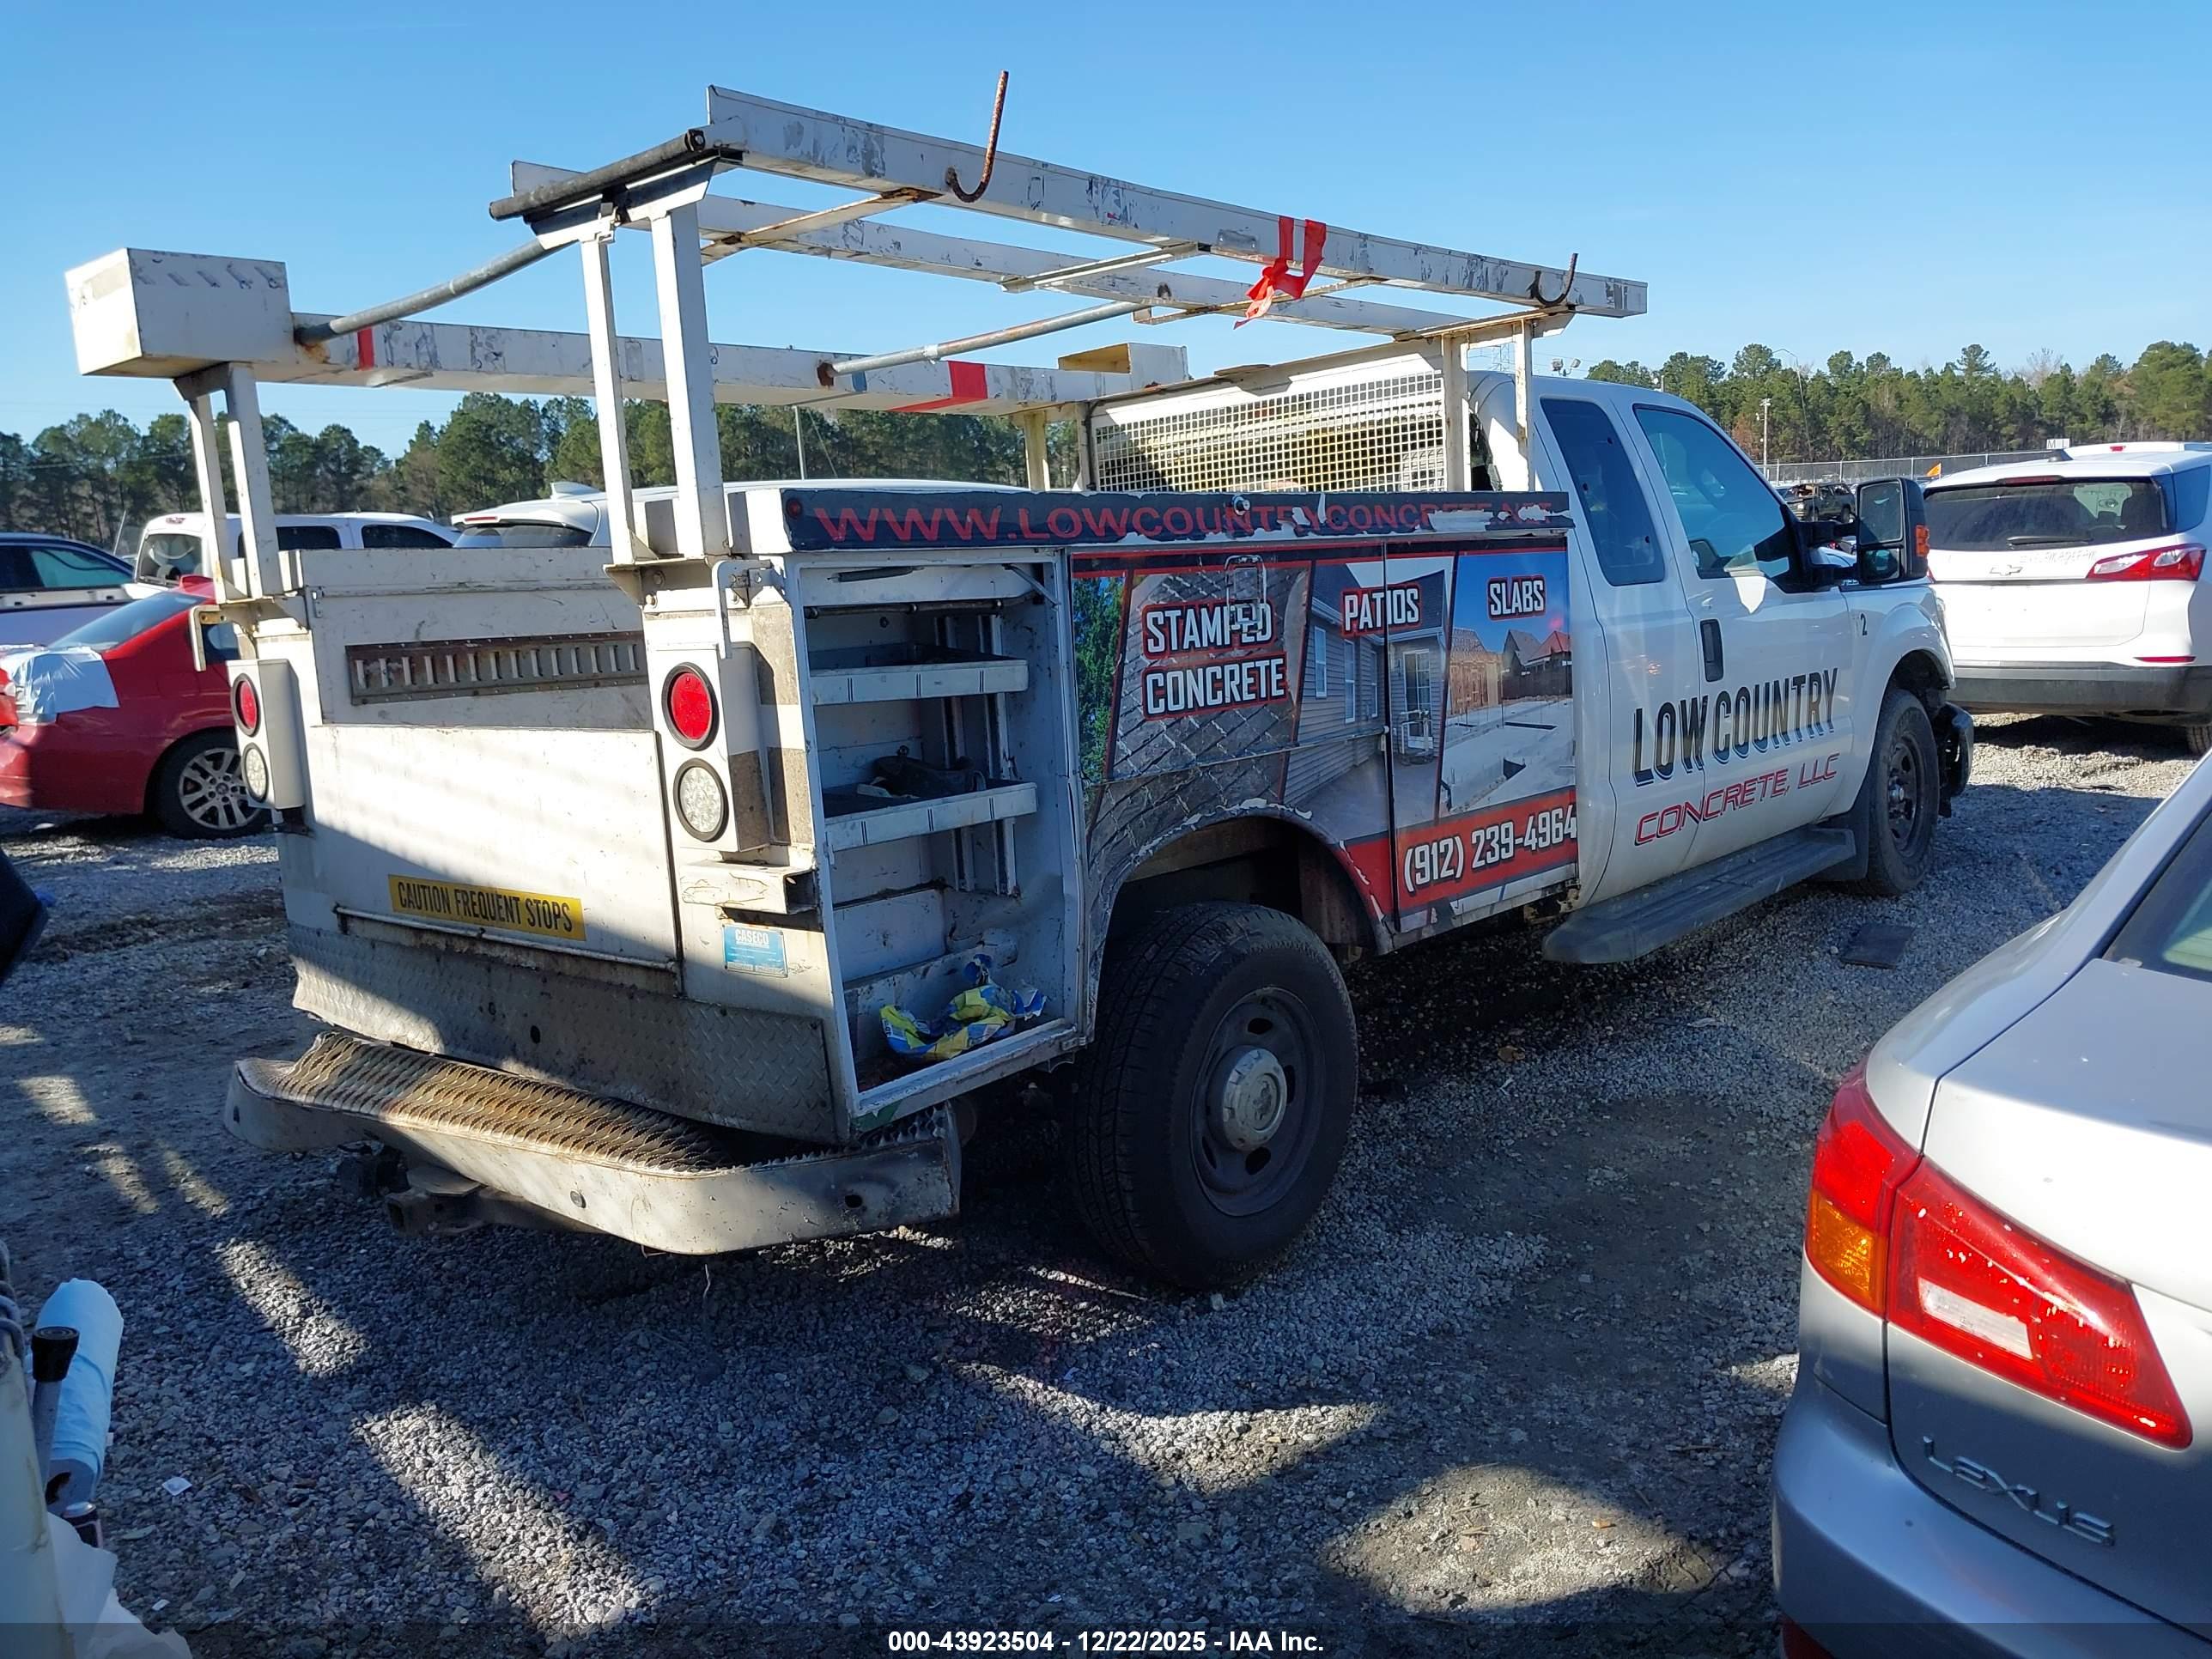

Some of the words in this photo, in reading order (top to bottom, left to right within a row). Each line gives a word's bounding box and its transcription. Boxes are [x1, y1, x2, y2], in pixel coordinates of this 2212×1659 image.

[1344, 588, 1419, 631] PATIOS
[1489, 580, 1546, 617] SLABS
[1860, 612, 1868, 636] 2
[1146, 658, 1285, 714] CONCRETE
[1634, 768, 1791, 847] CONCRETE,
[1797, 752, 1840, 789] LLC
[1404, 836, 1465, 892] (912)
[1471, 805, 1577, 870] 239-4964
[398, 881, 451, 915] CAUTION
[454, 888, 522, 925] FREQUENT
[525, 897, 573, 933] STOPS
[1922, 1435, 2116, 1547] LEXUS
